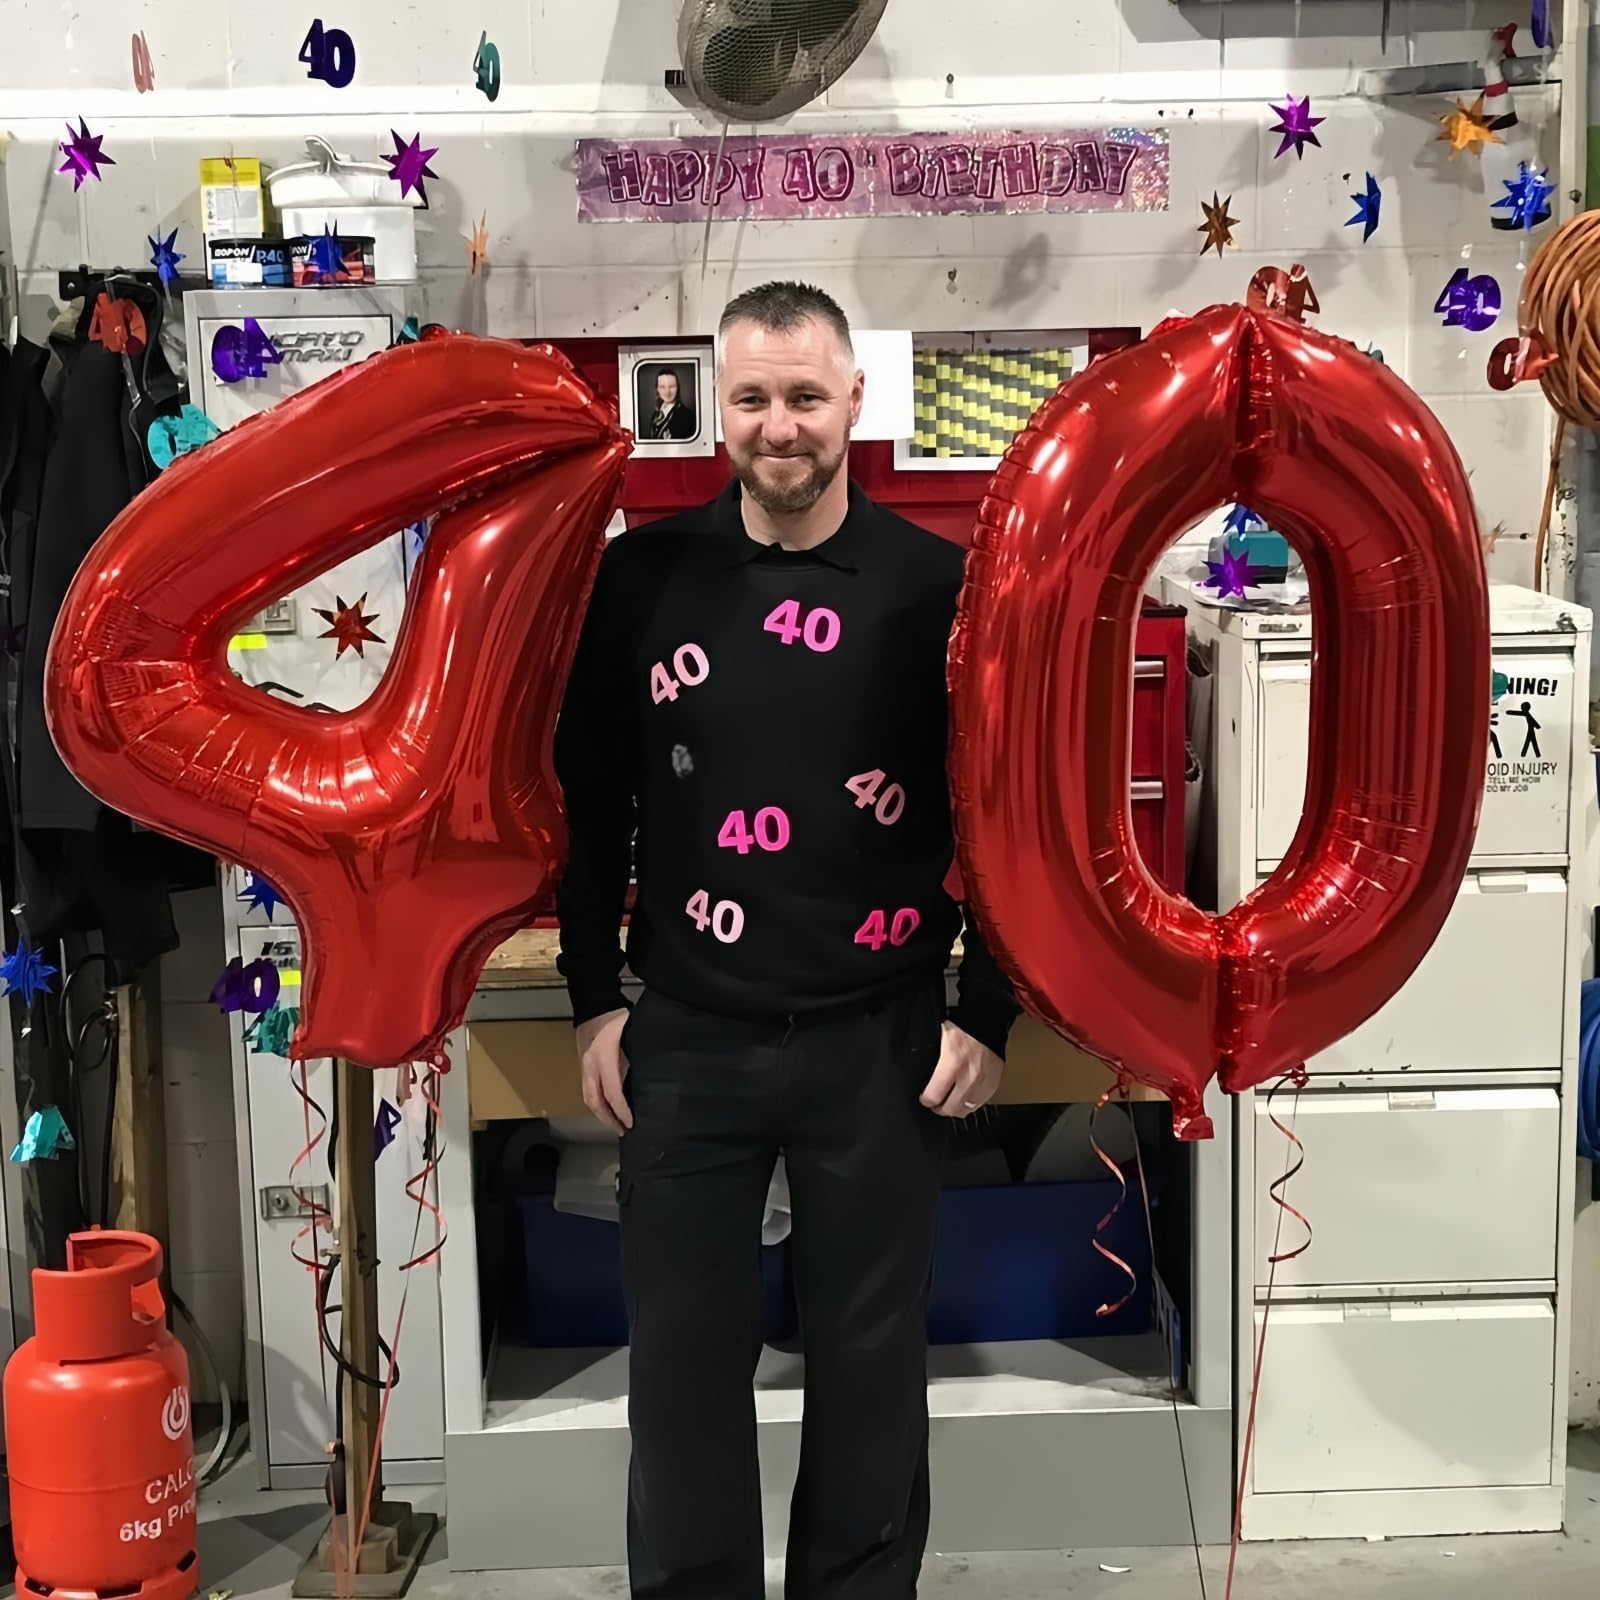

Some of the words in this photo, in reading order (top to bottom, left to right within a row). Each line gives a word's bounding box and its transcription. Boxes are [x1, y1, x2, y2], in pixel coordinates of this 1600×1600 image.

[298, 18, 356, 88] 40
[602, 147, 766, 206] HAPPY
[782, 146, 854, 201] 40
[1434, 268, 1502, 332] 40
[763, 599, 841, 652] 40
[650, 642, 710, 705] 40
[844, 768, 906, 826] 40
[1487, 762, 1510, 776] OID
[1512, 762, 1558, 776] INJURY
[717, 806, 790, 855] 40
[685, 888, 745, 944] 40
[854, 907, 920, 951] 40
[120, 1517, 162, 1542] 6kg
